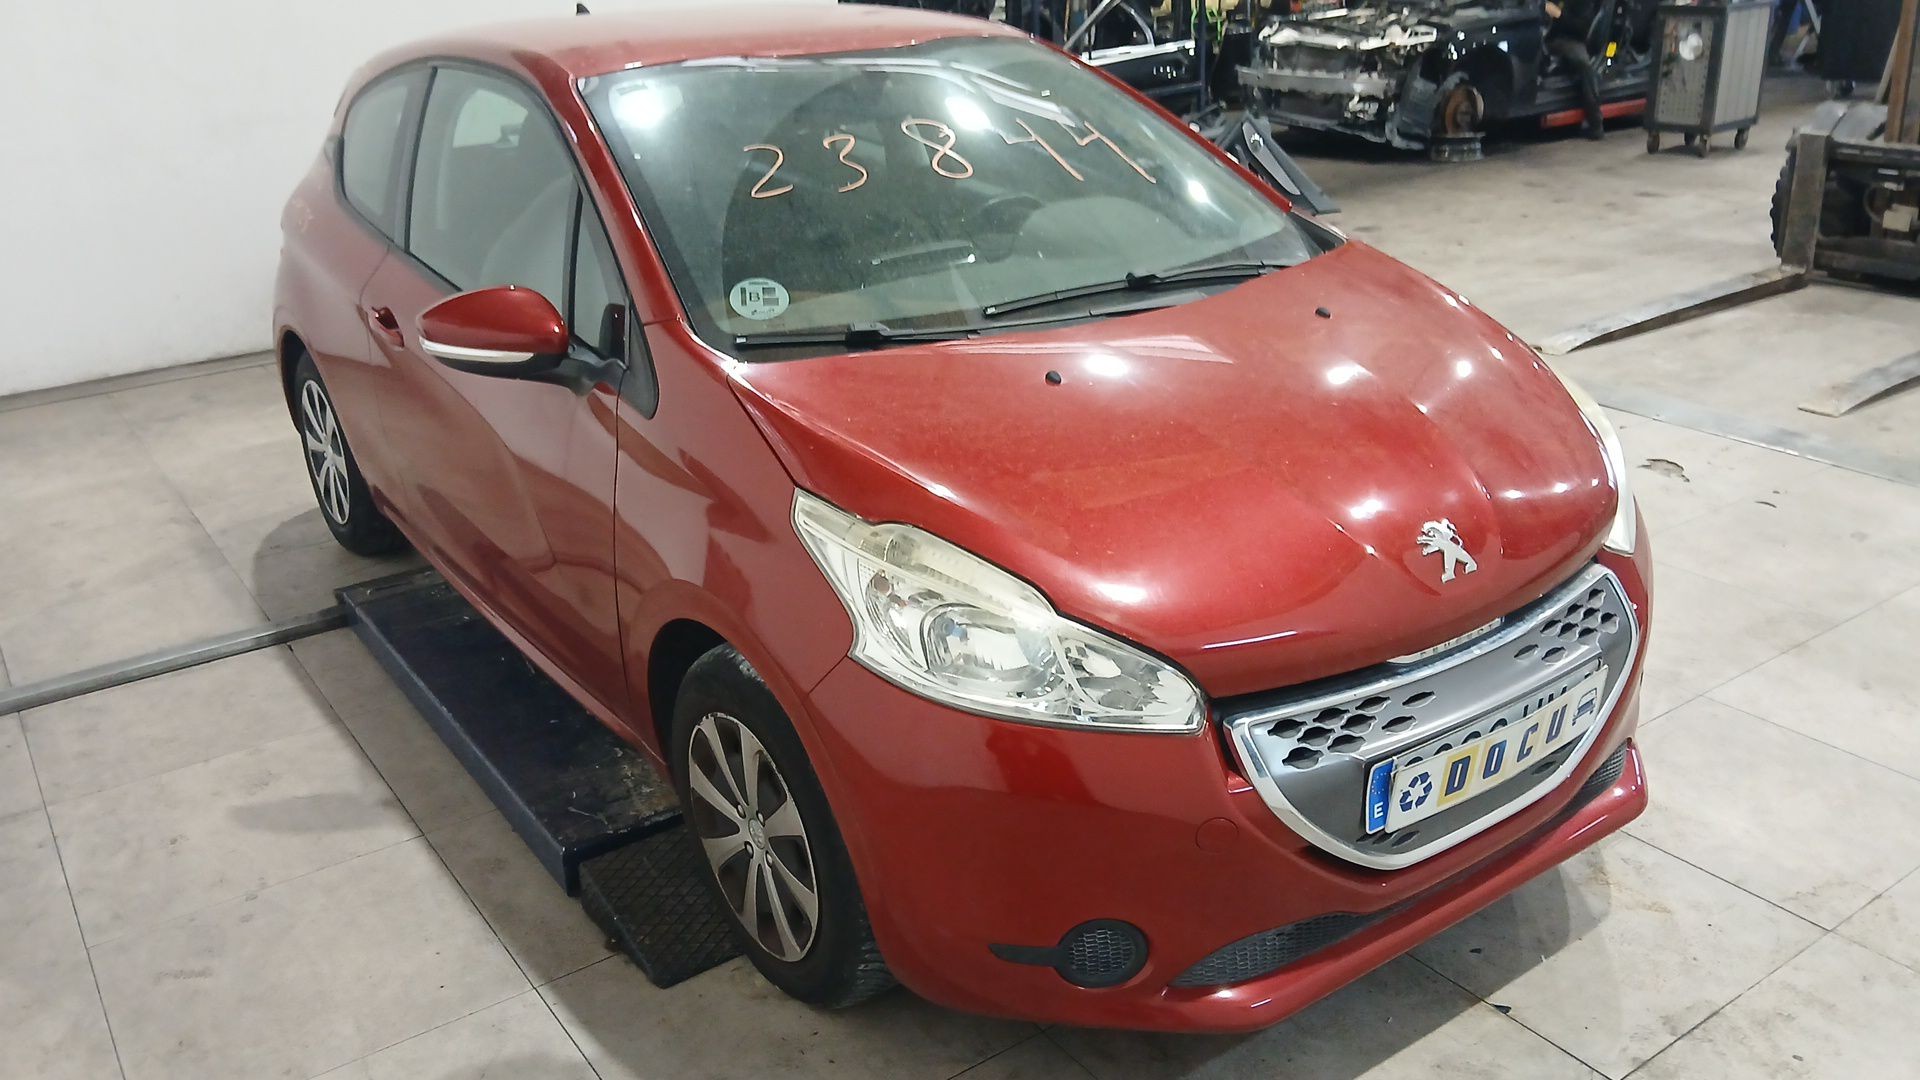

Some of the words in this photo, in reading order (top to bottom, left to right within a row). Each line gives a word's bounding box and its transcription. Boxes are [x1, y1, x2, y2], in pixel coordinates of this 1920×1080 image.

[743, 114, 1157, 198] 23844
[1444, 703, 1568, 796] DOCU
[1374, 801, 1384, 819] E
